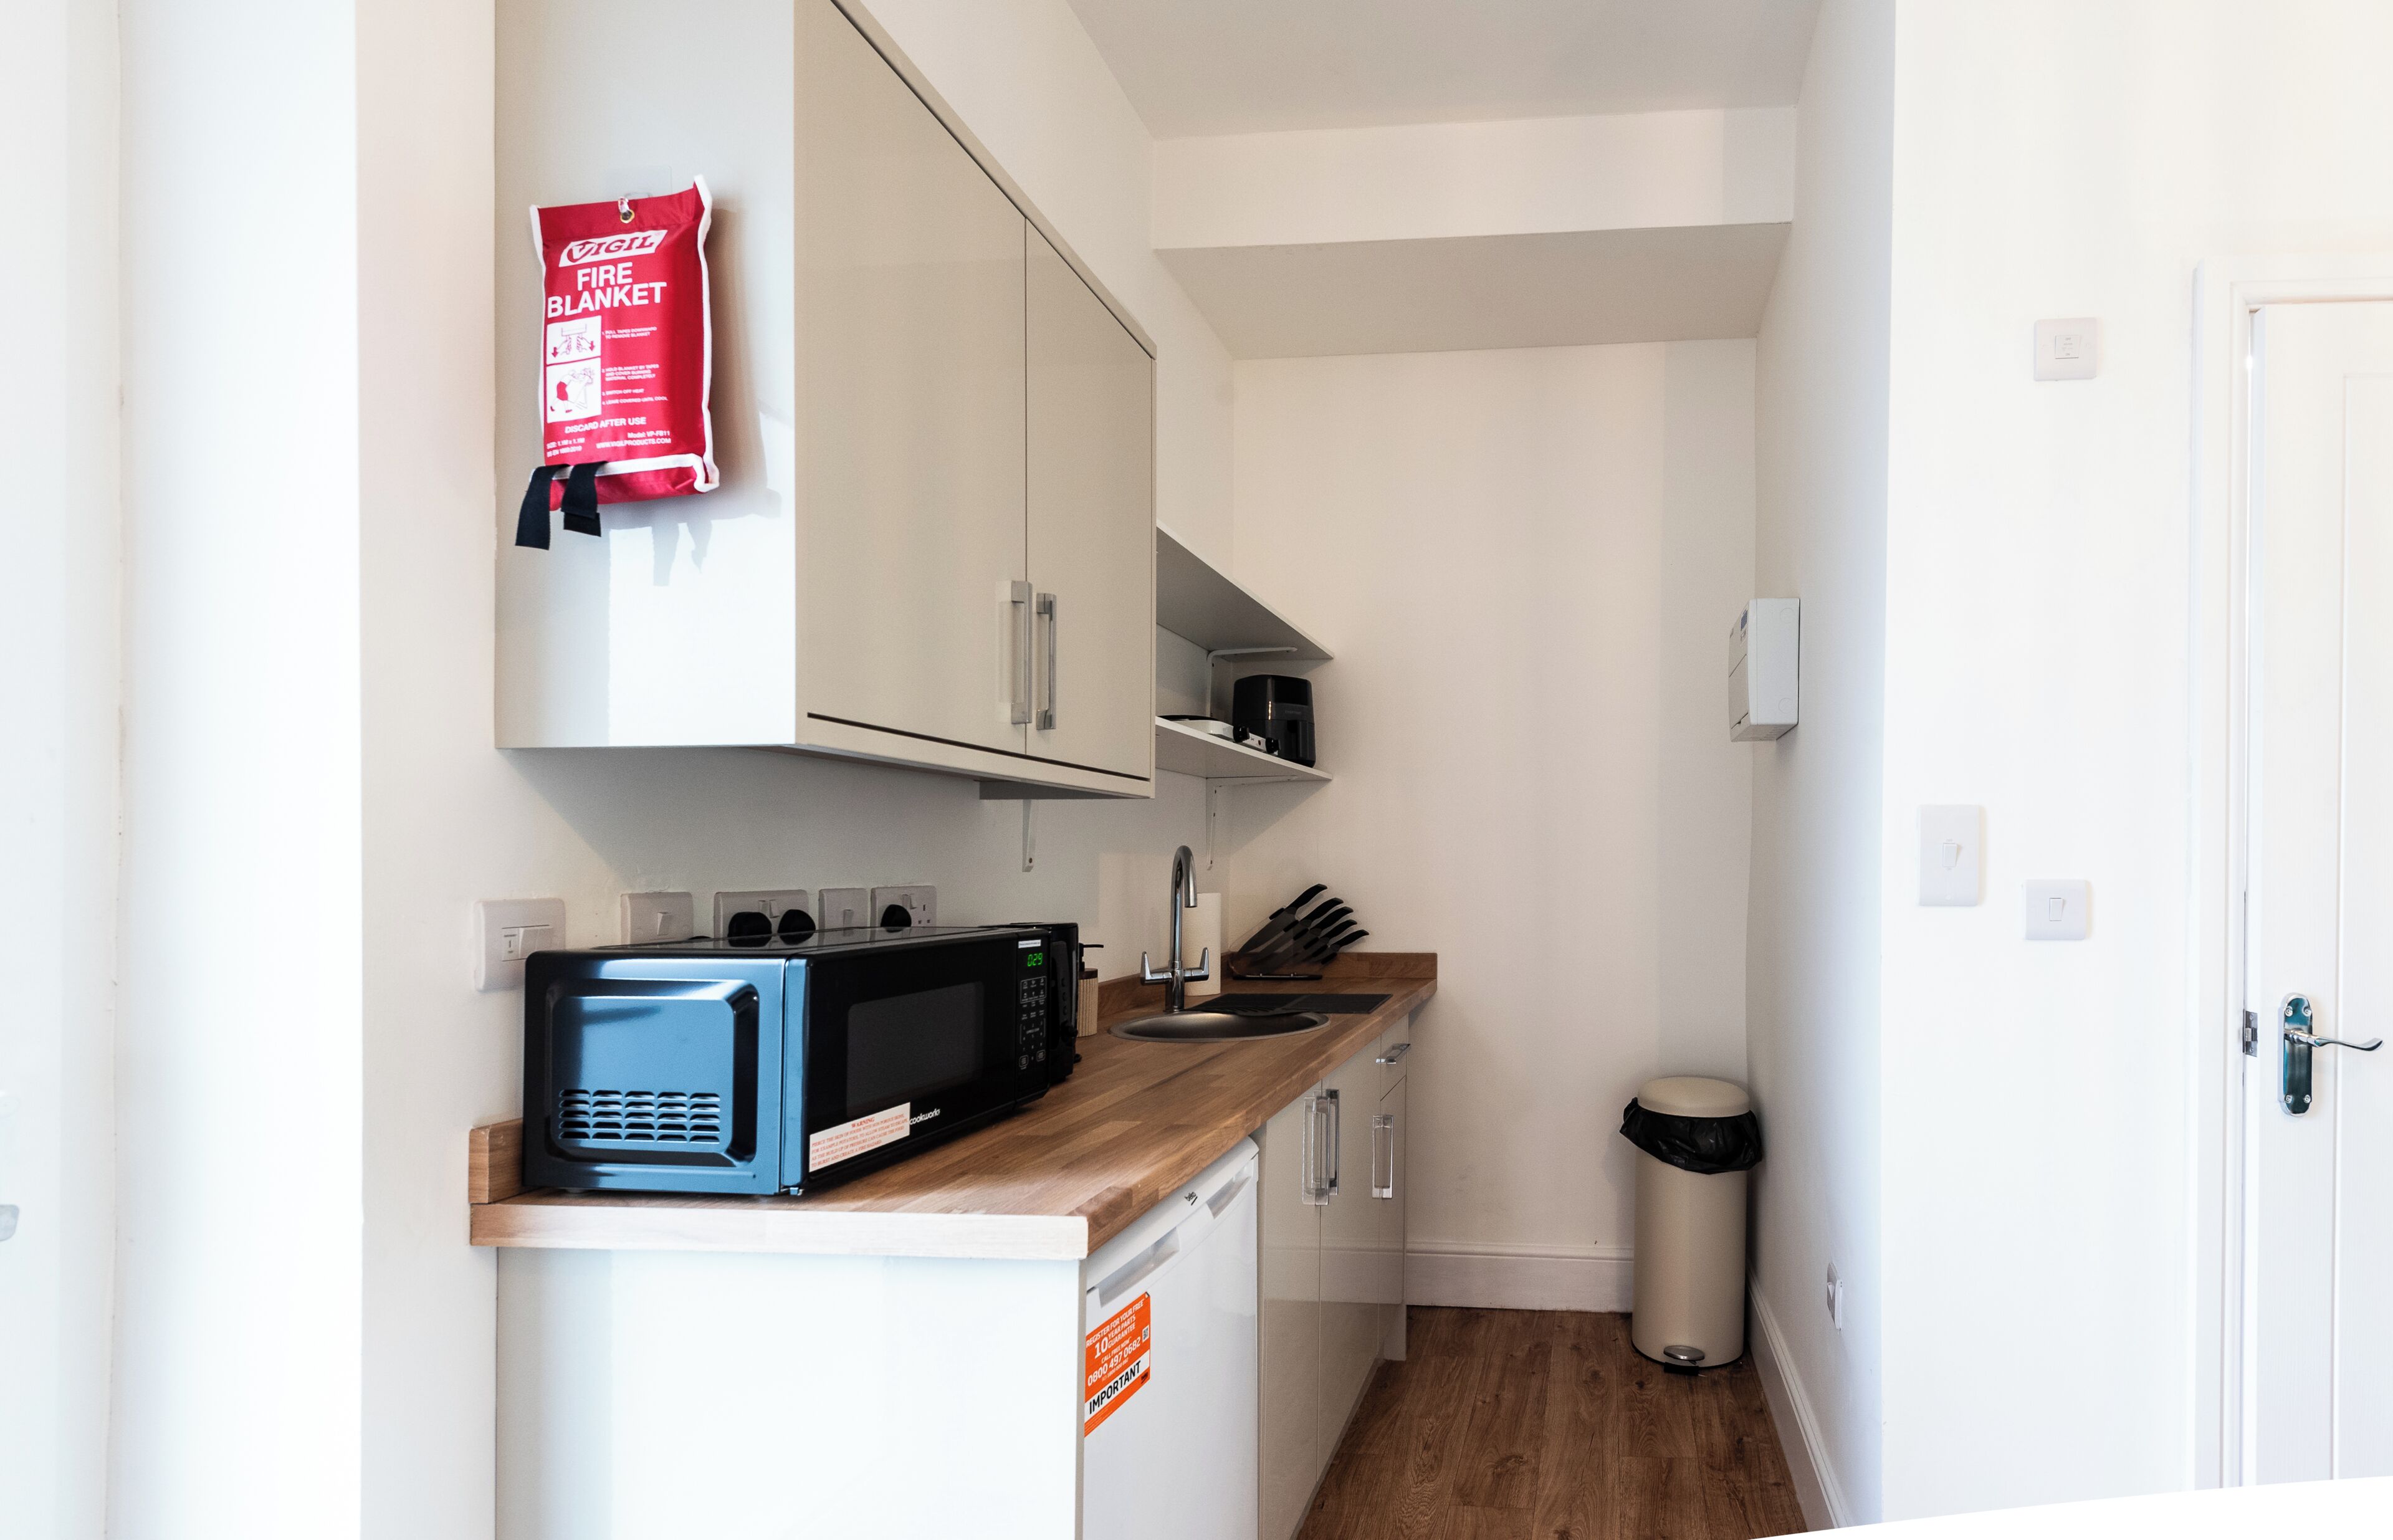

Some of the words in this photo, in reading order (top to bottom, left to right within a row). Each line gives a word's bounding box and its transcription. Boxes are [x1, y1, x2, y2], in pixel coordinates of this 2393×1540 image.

[566, 235, 656, 262] VIGIL
[577, 262, 633, 291] FIRE
[548, 282, 667, 318] BLANKET
[564, 421, 599, 434] DISCARD
[599, 418, 626, 428] AFTER
[628, 417, 647, 425] USE
[1086, 1325, 1110, 1348] REGISTER
[1110, 1318, 1120, 1330] FOR
[1120, 1308, 1132, 1322] YOUR
[1095, 1337, 1108, 1359] 10
[1109, 1326, 1121, 1339] YEAR
[1121, 1314, 1135, 1329] PARTS
[1108, 1322, 1135, 1348] GUARANTEE
[1088, 1363, 1108, 1386] 0800
[1109, 1351, 1123, 1369] 497
[1124, 1336, 1140, 1357] 0682
[1102, 1352, 1111, 1364] CALL
[1111, 1345, 1120, 1356] FREE
[1089, 1361, 1141, 1414] IMPORTANT
